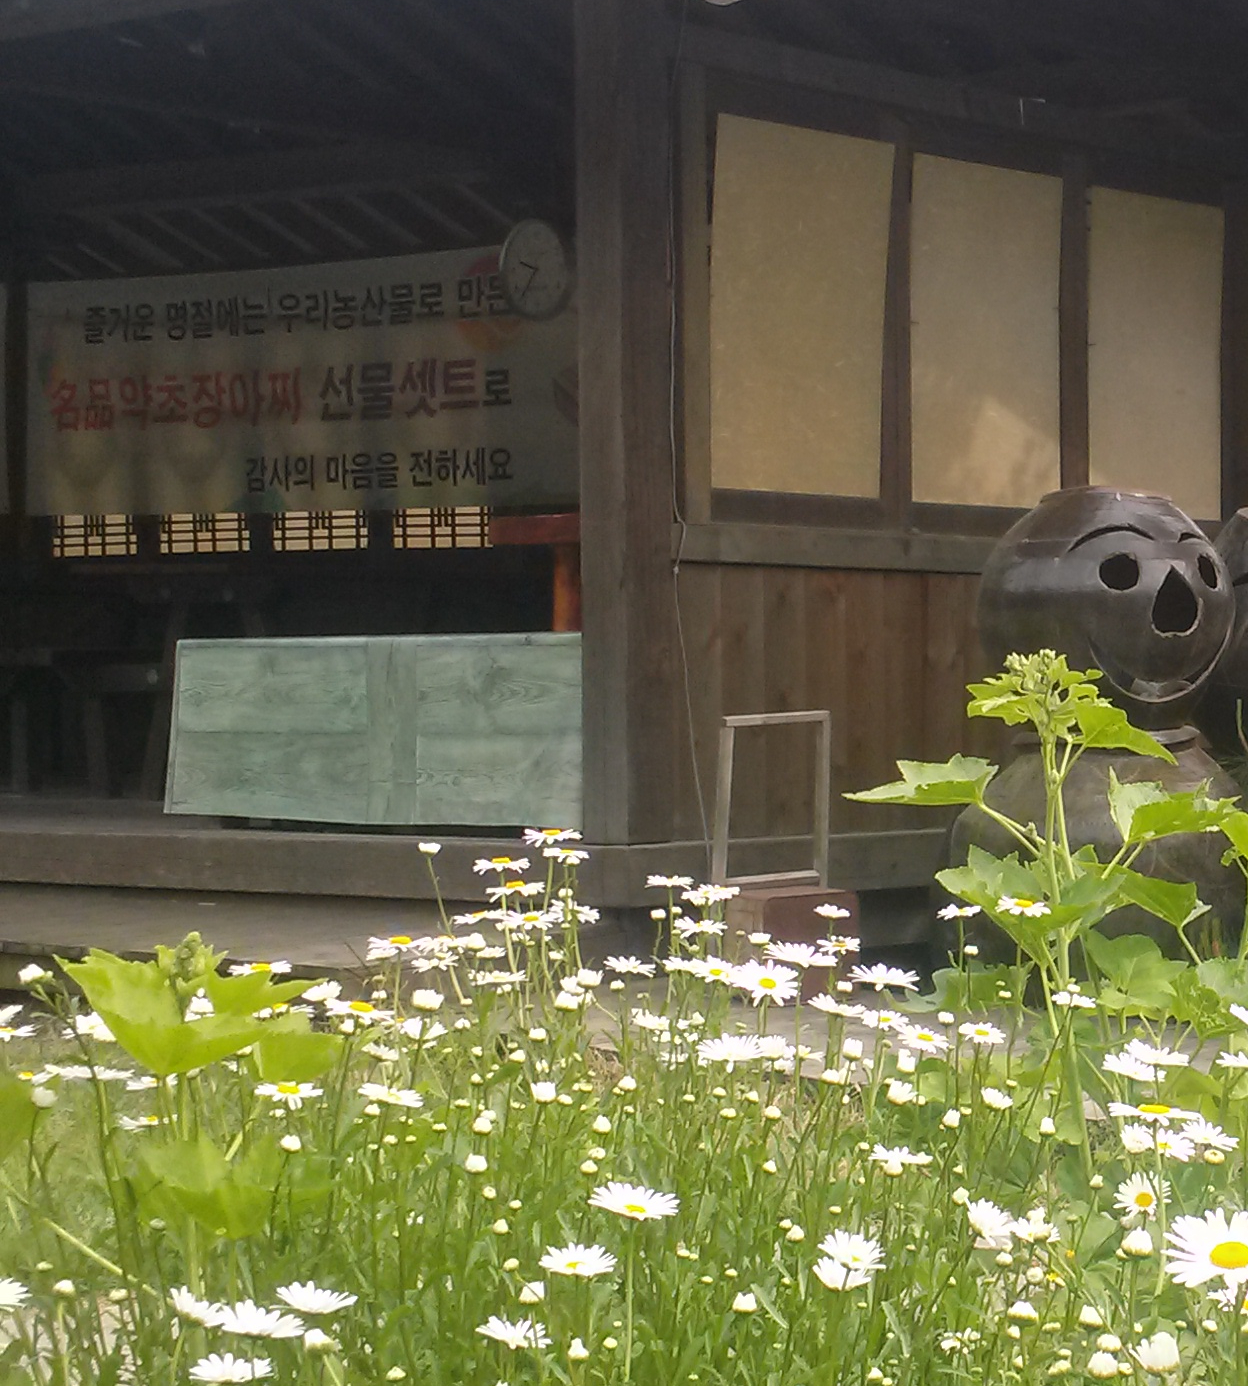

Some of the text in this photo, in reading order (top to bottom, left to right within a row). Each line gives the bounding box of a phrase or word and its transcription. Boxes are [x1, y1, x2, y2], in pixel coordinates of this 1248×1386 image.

[83, 303, 154, 345] 즐거운
[166, 295, 267, 342] 명절에는
[276, 281, 445, 333] 우리농산물로
[318, 358, 512, 422] 선물셋트로
[245, 446, 514, 493] 감사의 마음을 전하세요
